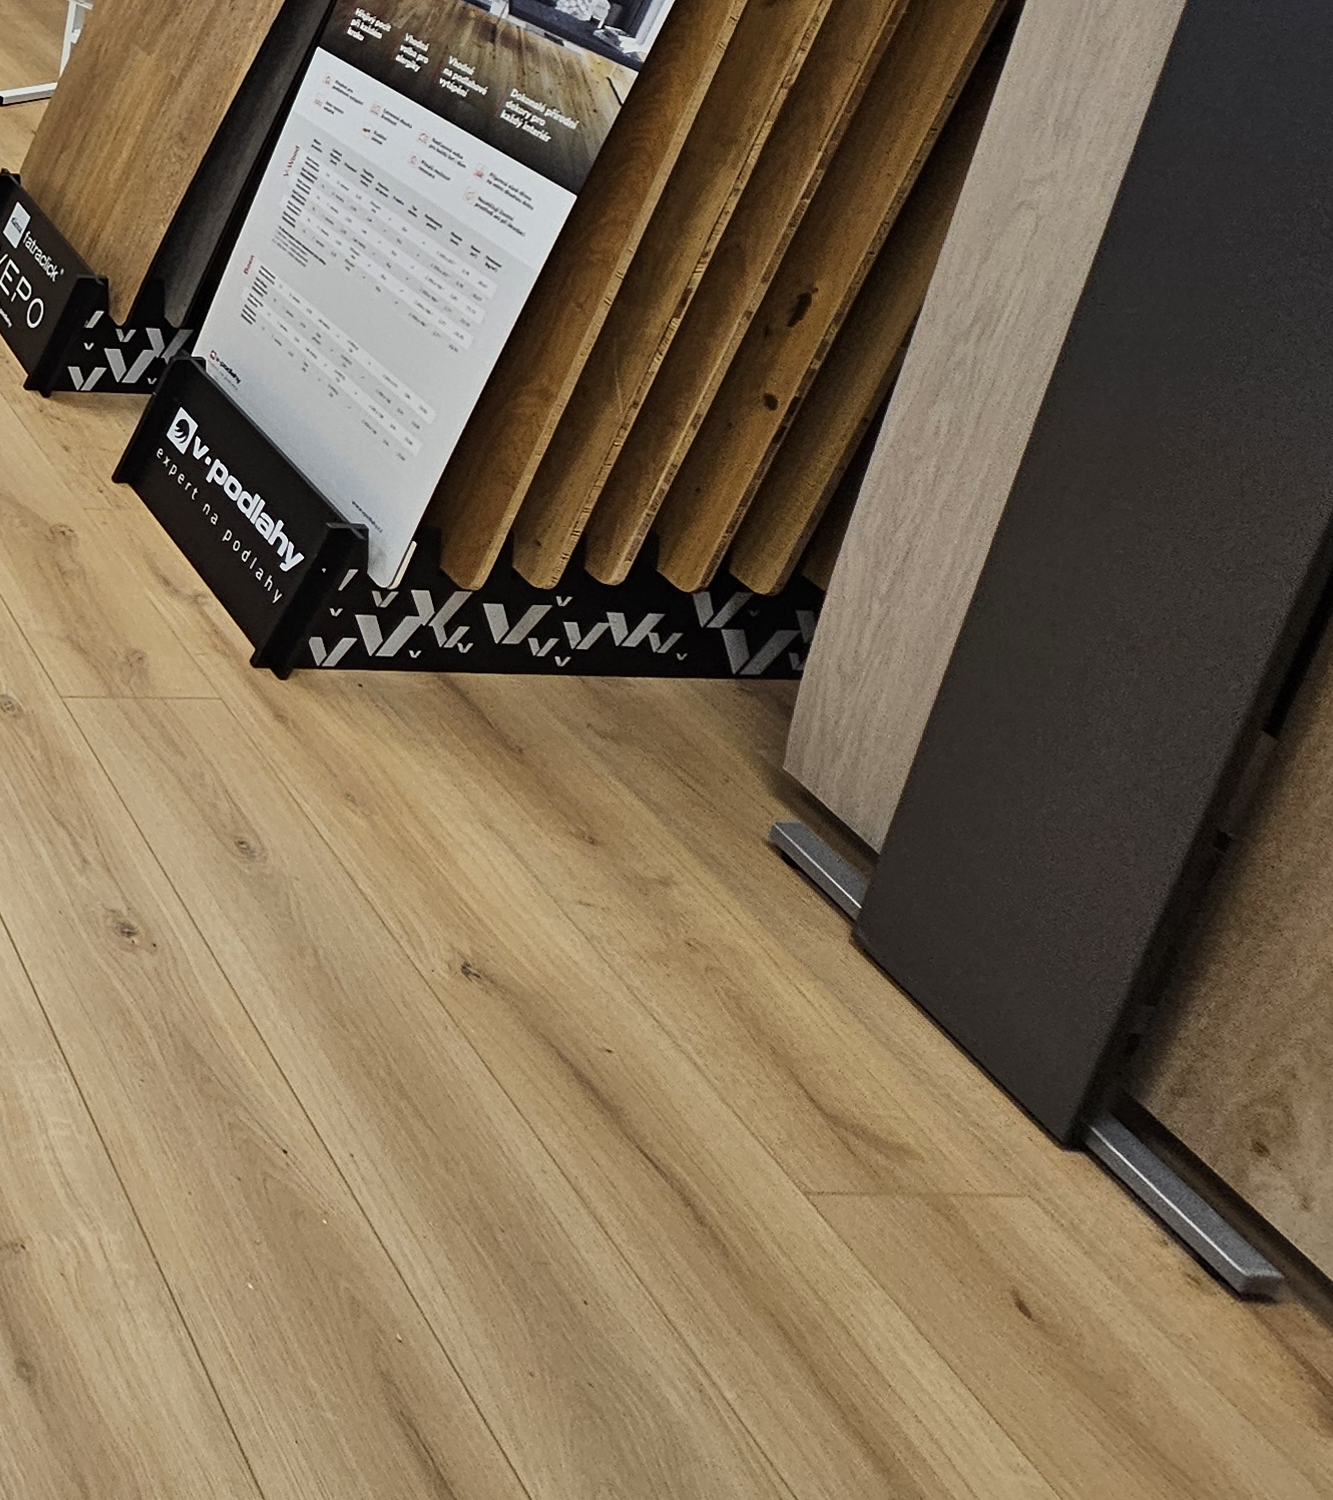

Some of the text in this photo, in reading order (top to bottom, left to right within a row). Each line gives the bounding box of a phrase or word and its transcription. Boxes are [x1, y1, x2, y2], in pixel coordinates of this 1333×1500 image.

[156, 446, 284, 604] expert na podlahy
